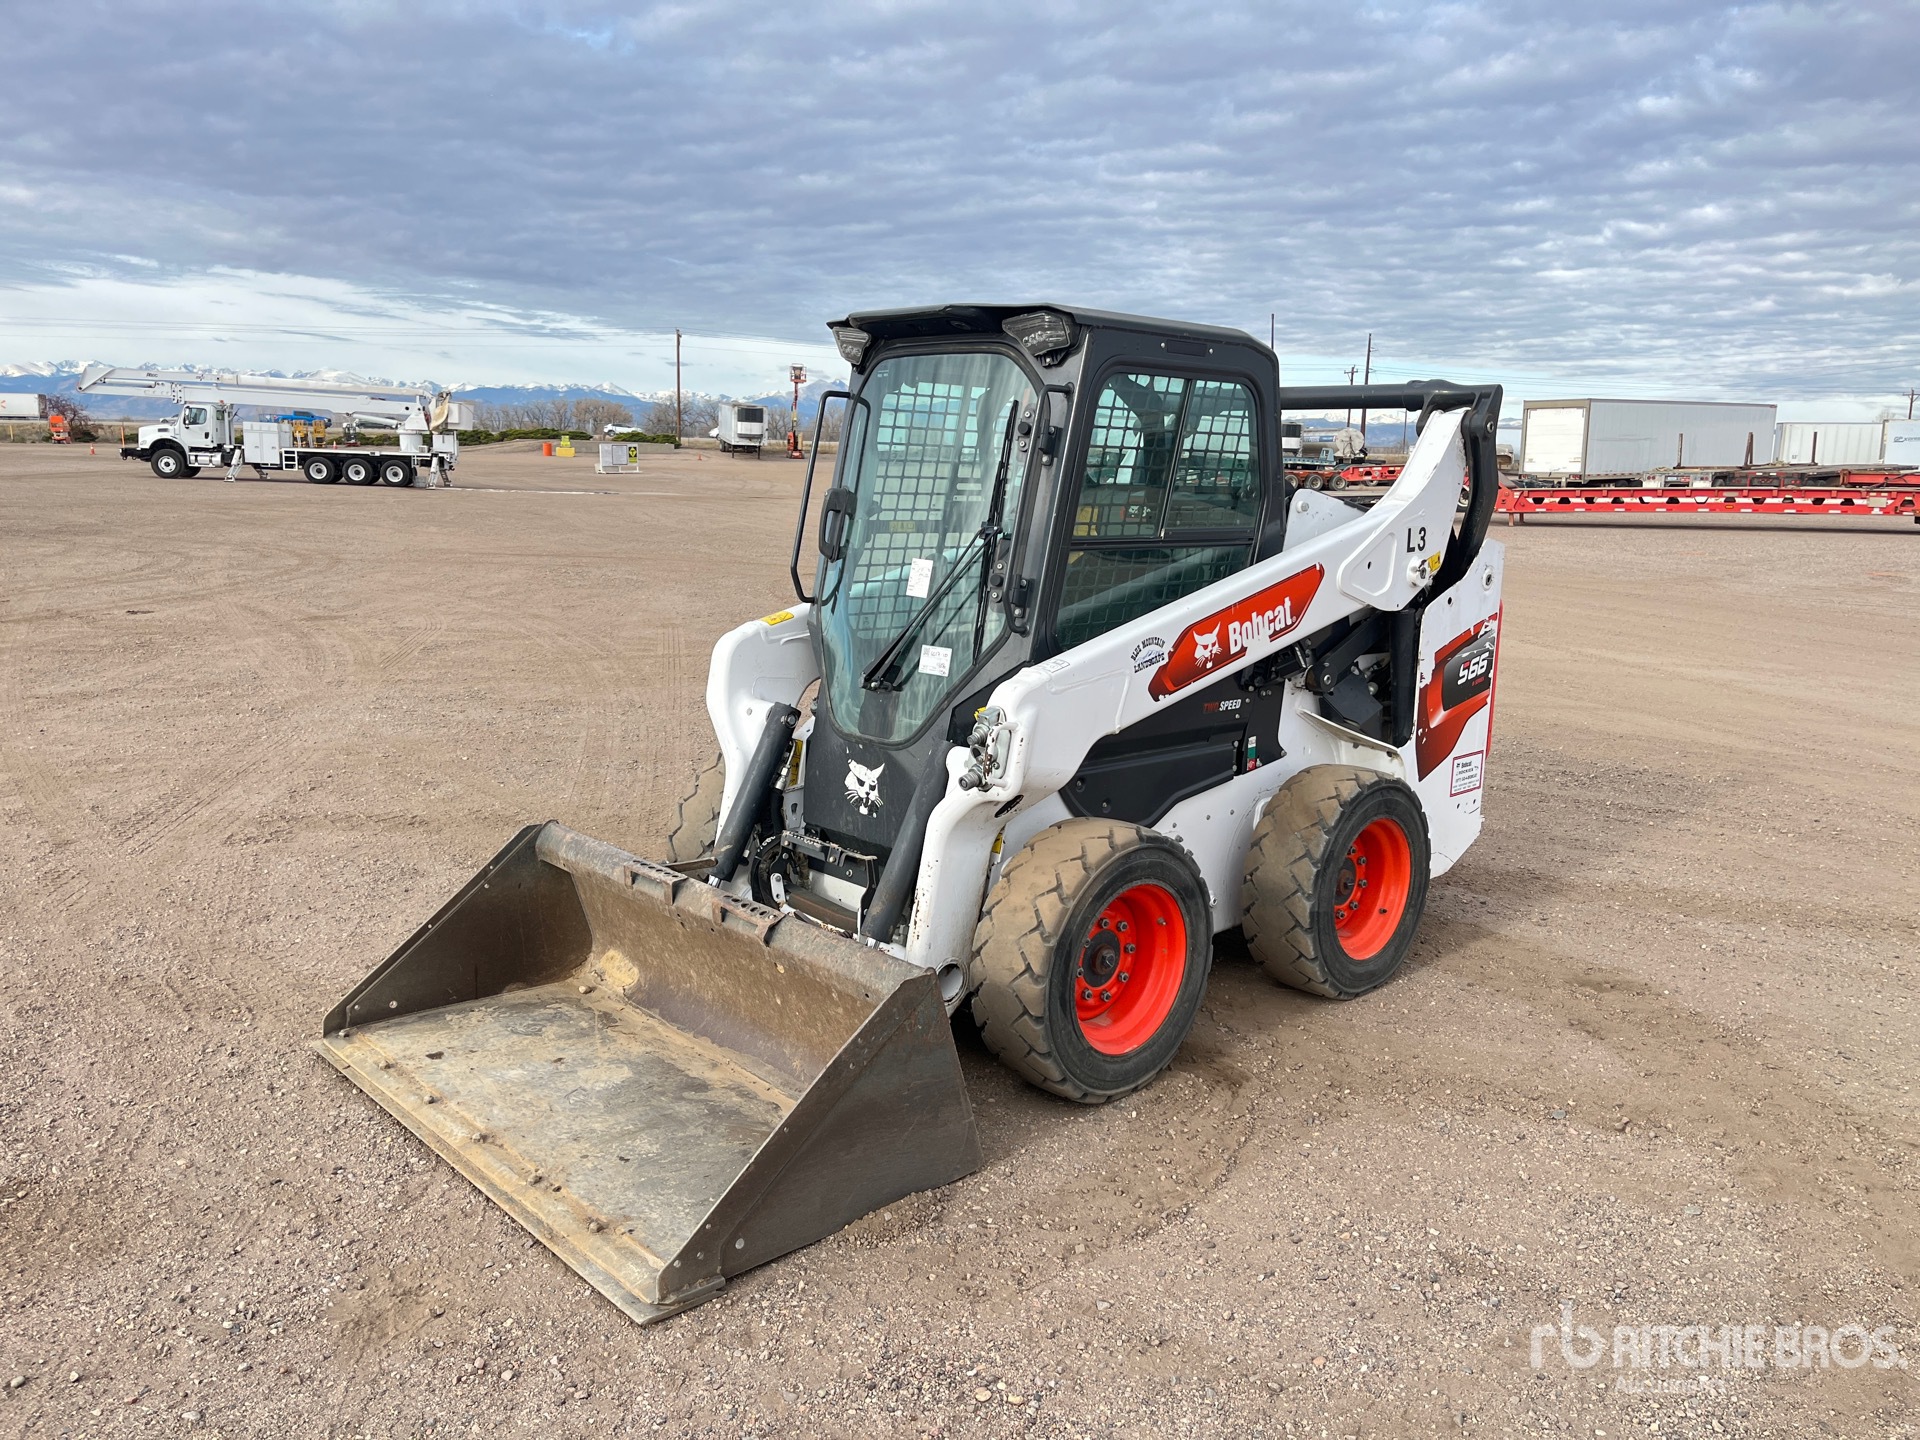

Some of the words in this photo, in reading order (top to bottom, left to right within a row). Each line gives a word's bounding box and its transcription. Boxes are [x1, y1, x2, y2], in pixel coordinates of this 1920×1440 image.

[1406, 526, 1427, 553] L3
[1228, 596, 1292, 655] Bobcat
[1141, 636, 1165, 649] MOUNTAIN
[1133, 652, 1165, 673] LANDSCAPE
[1457, 651, 1490, 686] S66
[1219, 699, 1242, 712] SPEED
